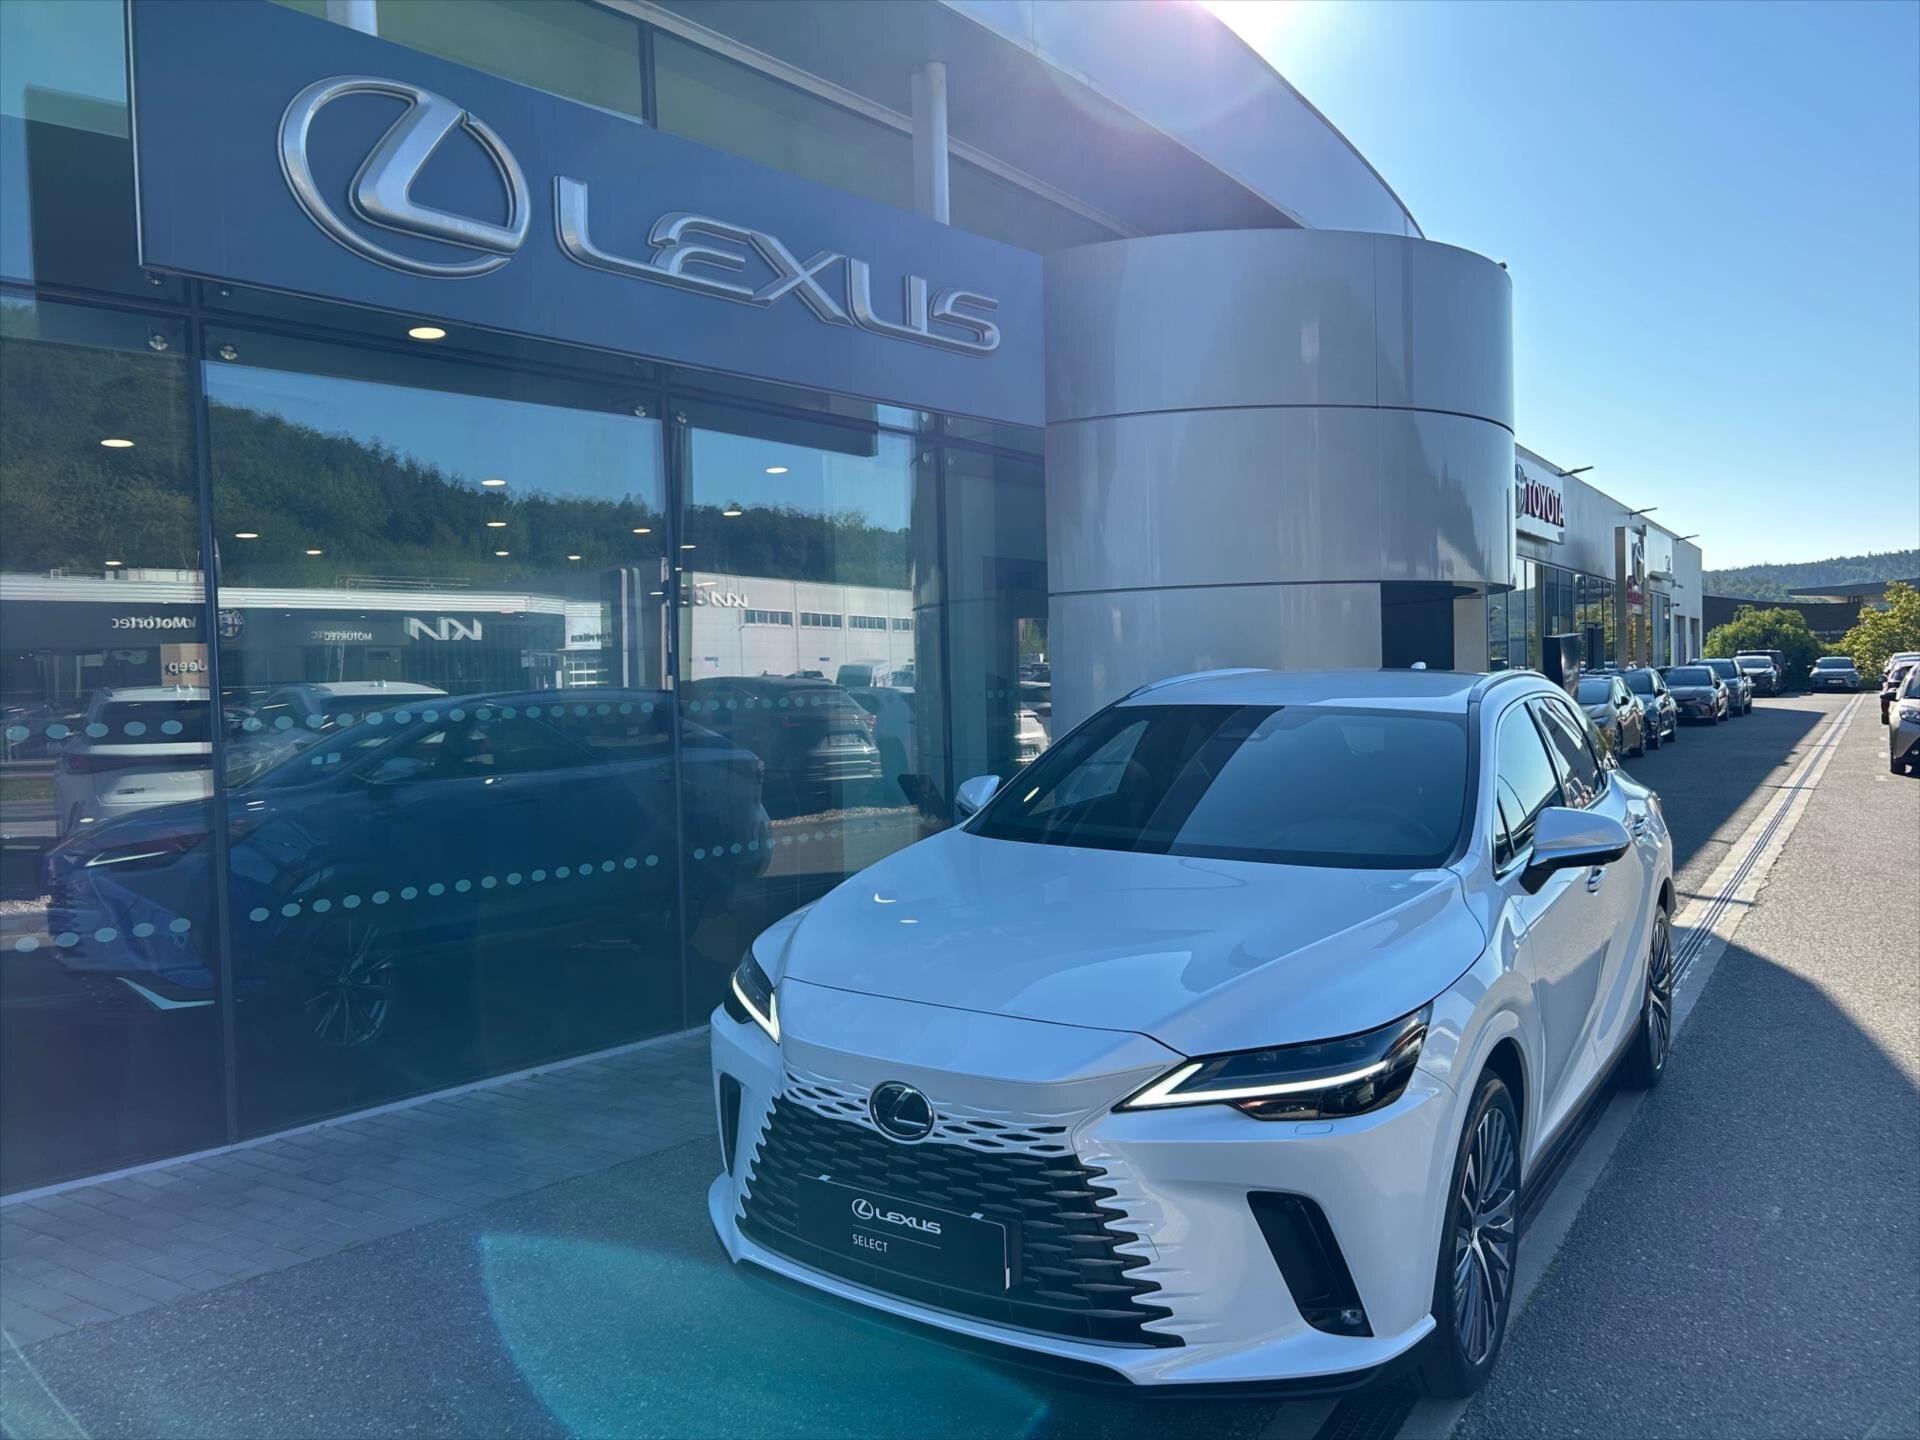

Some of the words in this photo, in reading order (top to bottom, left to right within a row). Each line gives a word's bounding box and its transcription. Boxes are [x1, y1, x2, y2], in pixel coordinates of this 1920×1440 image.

[553, 174, 1002, 355] LEXUS
[1524, 477, 1565, 527] TOYOTA
[875, 1207, 942, 1235] LEXUS
[852, 1233, 889, 1254] SELECT
